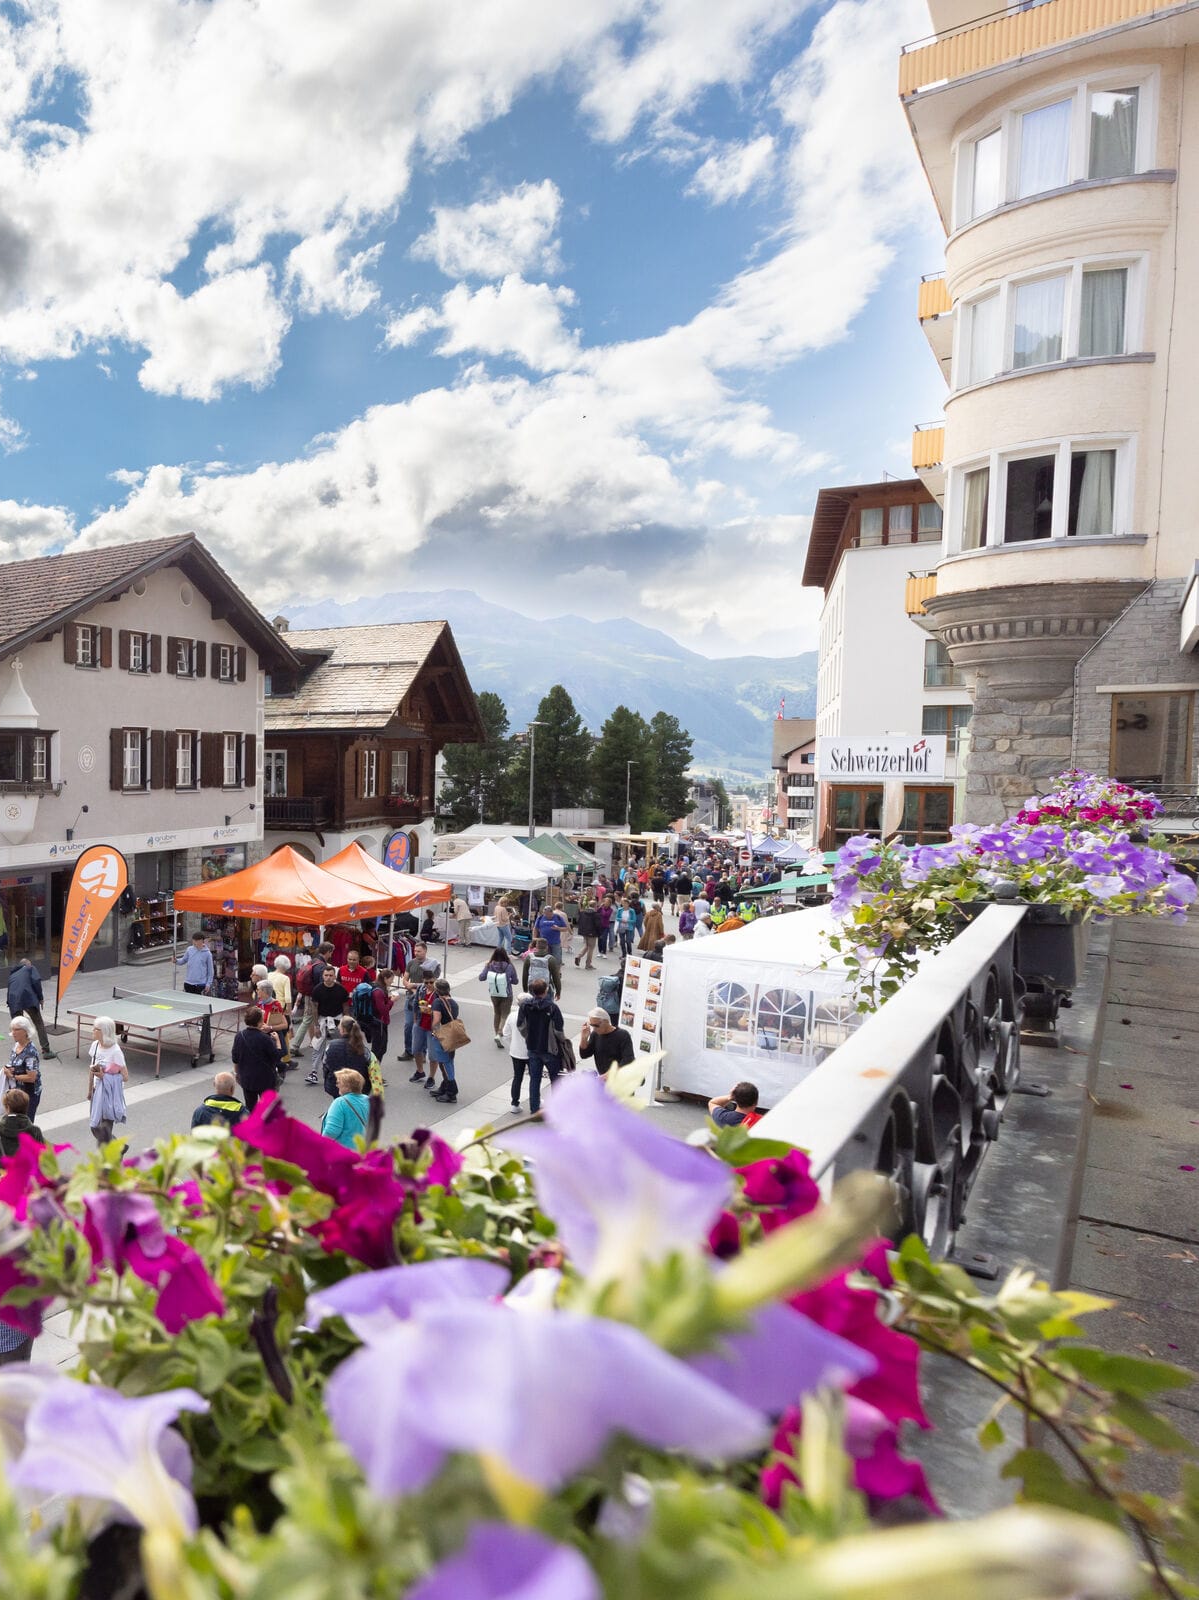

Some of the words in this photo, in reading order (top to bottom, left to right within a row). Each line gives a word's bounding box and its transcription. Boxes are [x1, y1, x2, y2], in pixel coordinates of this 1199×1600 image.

[830, 747, 932, 773] Schweizerhof
[59, 843, 87, 853] gruber
[62, 894, 93, 968] gruber
[74, 913, 94, 958] SPORT
